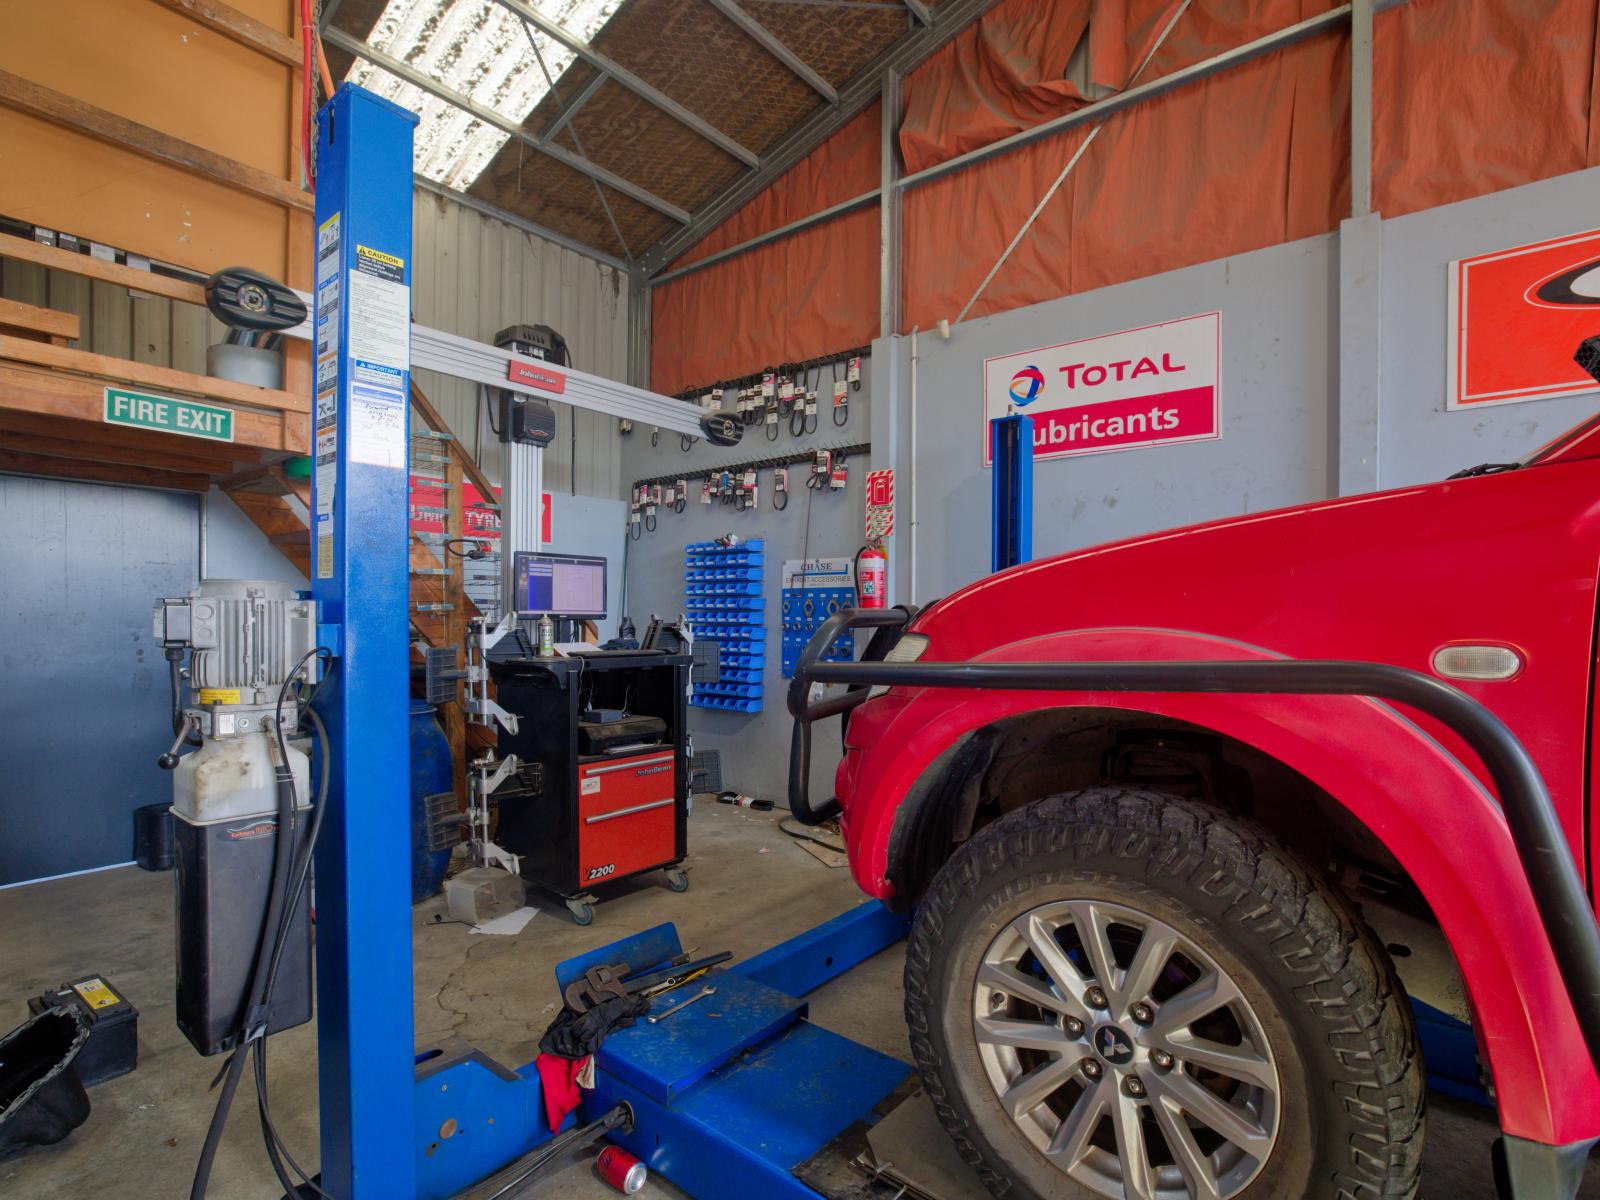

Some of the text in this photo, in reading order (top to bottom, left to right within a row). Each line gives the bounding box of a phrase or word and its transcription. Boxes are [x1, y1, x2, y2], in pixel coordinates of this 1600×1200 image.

[367, 250, 399, 265] CAUTION
[367, 363, 398, 375] IMPORTANT
[1059, 353, 1186, 389] TOTAL
[113, 396, 226, 433] FIRE EXIT
[1032, 406, 1180, 447] ubricants
[800, 562, 833, 573] CHASE
